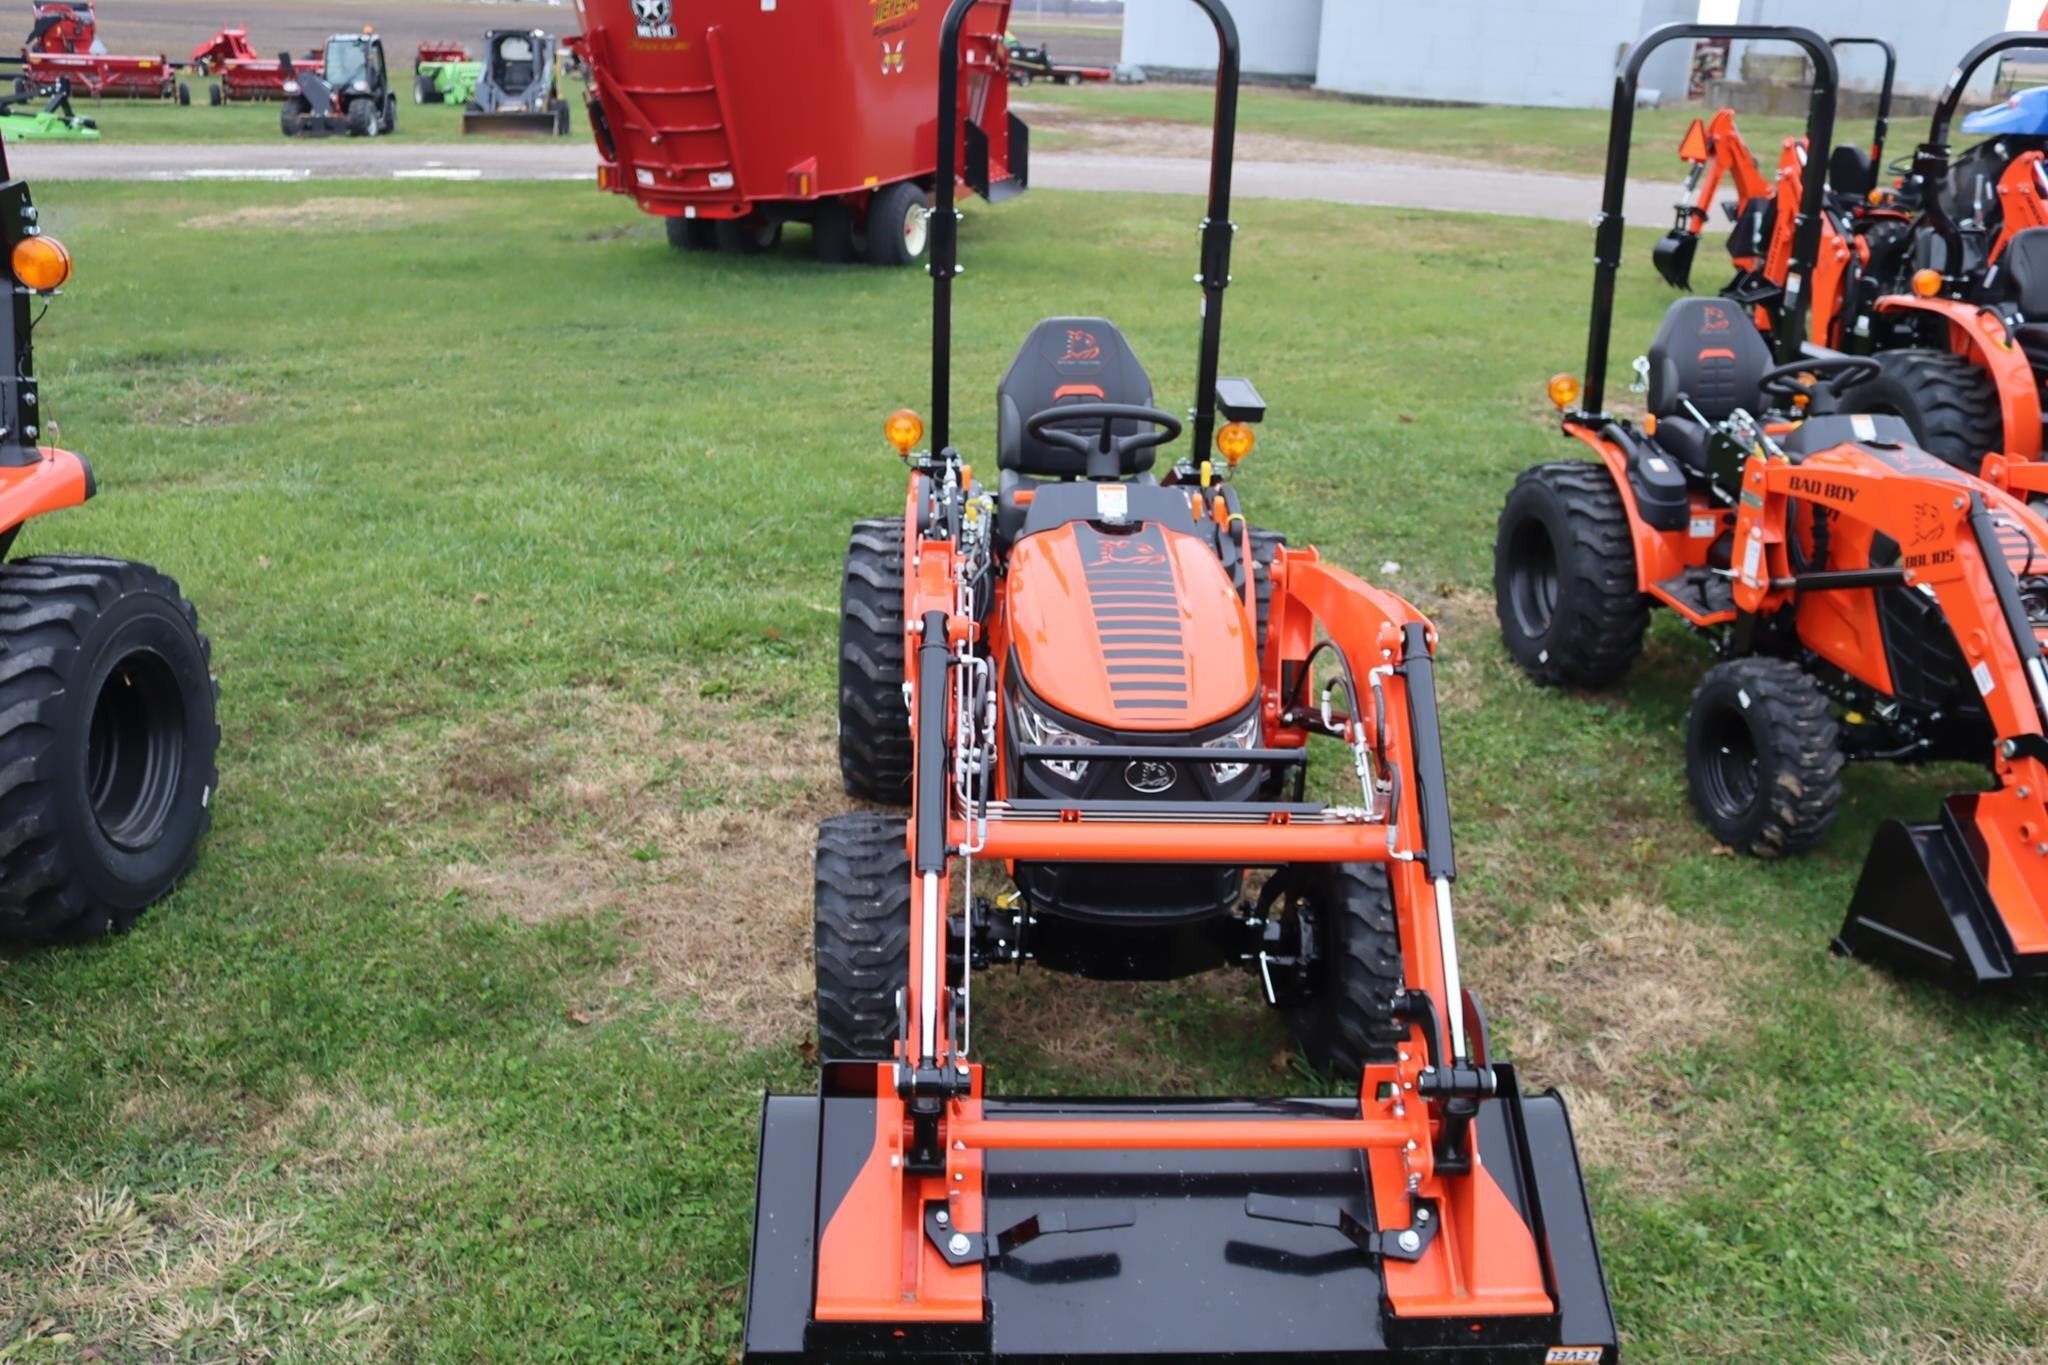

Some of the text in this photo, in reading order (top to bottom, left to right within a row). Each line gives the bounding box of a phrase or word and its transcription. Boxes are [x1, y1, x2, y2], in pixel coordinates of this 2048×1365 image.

[1789, 475, 1859, 503] BAD BOY
[1551, 1351, 1600, 1361] LEVEL
